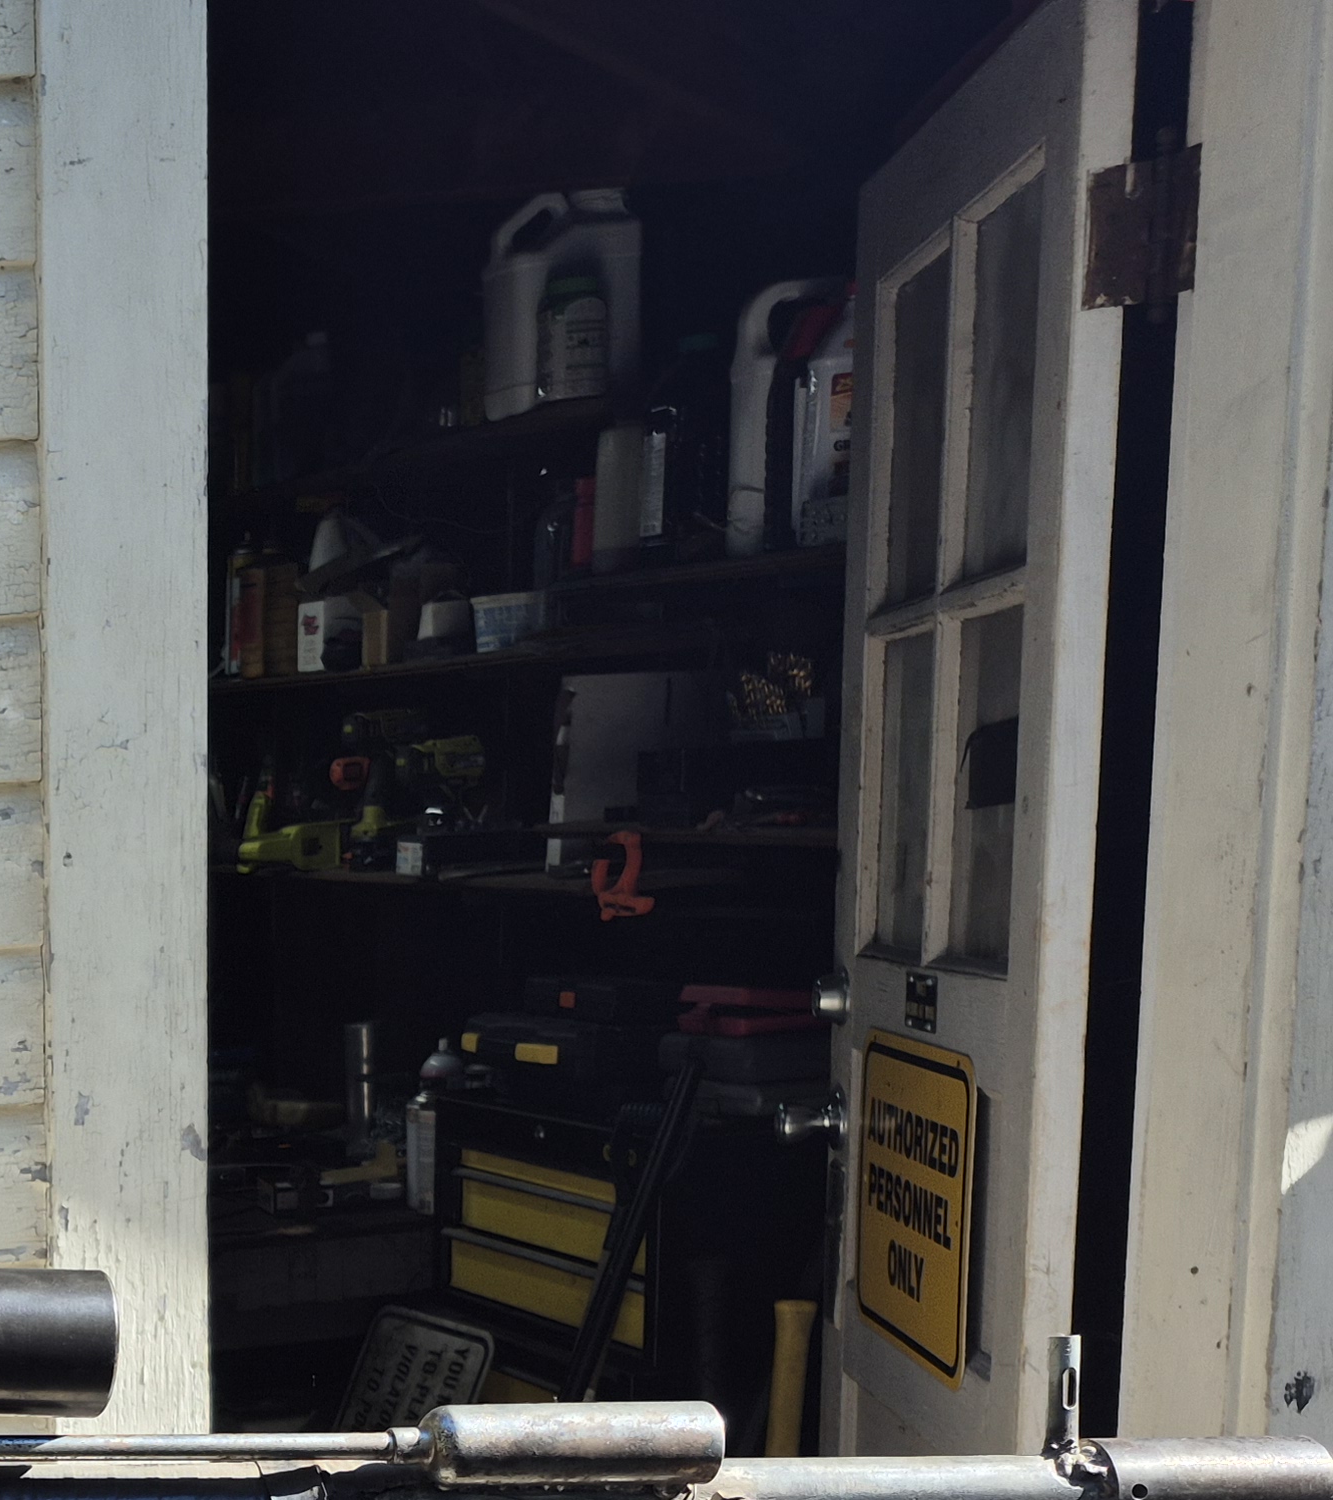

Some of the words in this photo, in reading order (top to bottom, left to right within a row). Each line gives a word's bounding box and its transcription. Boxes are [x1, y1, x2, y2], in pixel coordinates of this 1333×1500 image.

[868, 1096, 960, 1179] AUTHORIZED
[868, 1162, 952, 1251] PERSONNEL
[887, 1239, 925, 1303] ONLY
[443, 1347, 471, 1391] YOU
